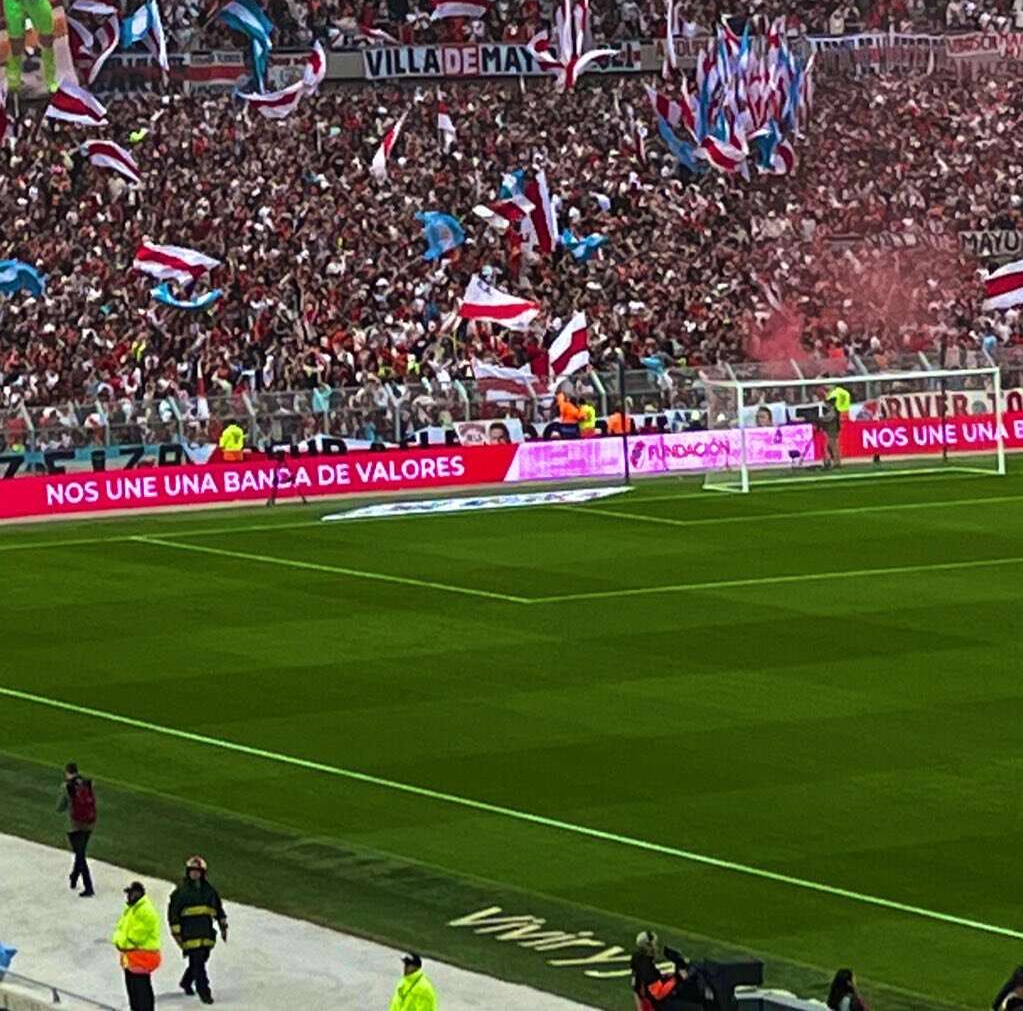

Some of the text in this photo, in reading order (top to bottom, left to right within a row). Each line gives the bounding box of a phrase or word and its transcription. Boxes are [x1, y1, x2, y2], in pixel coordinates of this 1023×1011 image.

[366, 46, 440, 76] VILLA
[444, 45, 478, 75] DE
[481, 44, 558, 74] MAY
[861, 425, 908, 449] NOS
[913, 423, 958, 446] UNE
[962, 421, 1009, 442] UNA
[46, 456, 465, 506] NOS UNE UNA BANCA DE VALORES
